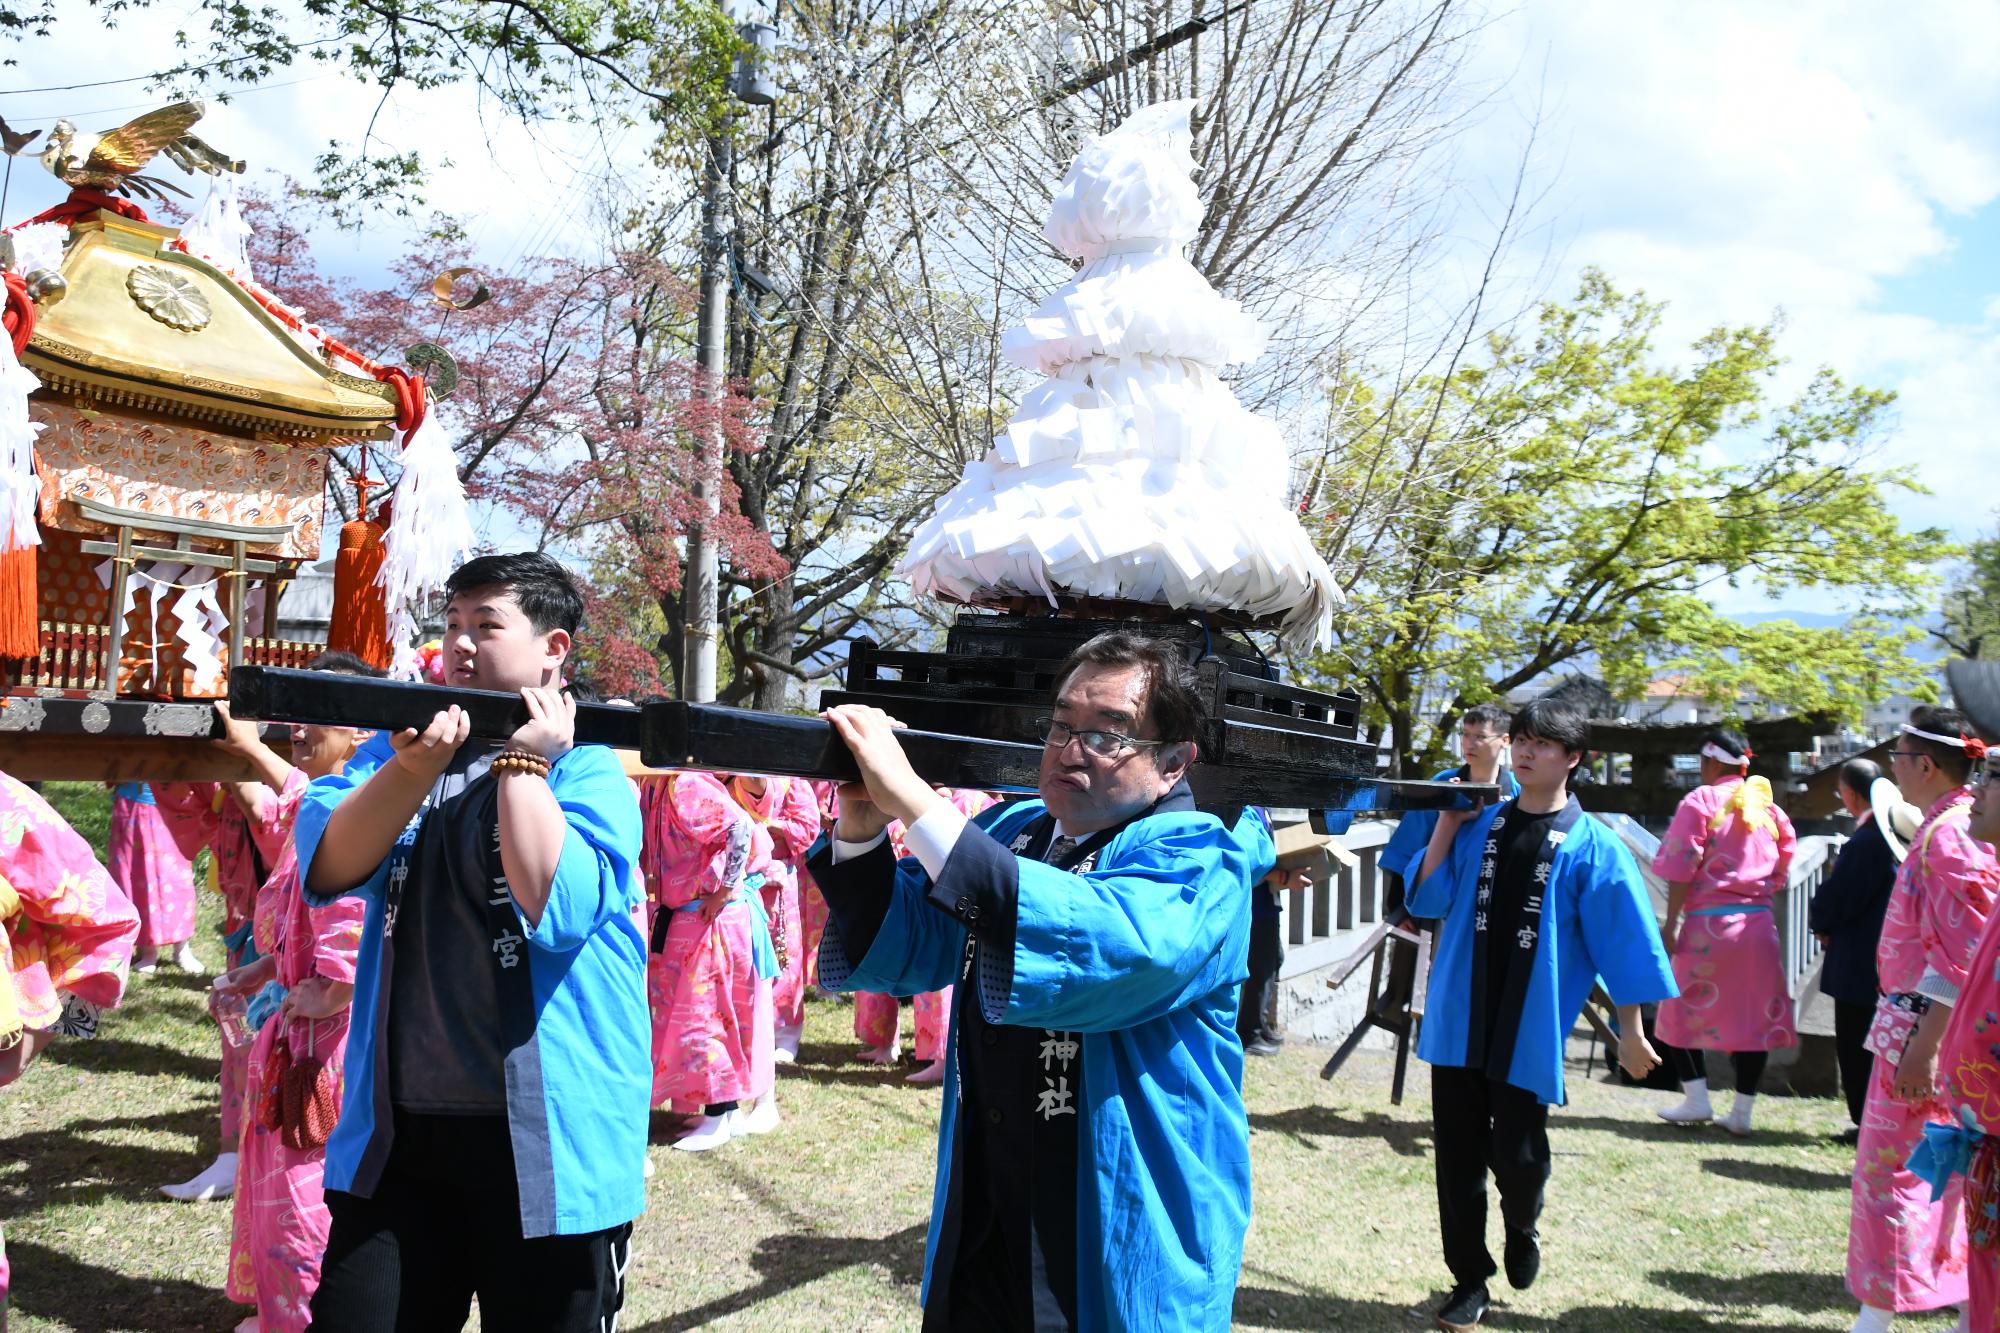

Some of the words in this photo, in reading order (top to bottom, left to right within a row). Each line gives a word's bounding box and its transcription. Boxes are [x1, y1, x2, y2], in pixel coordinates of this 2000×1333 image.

[1516, 829, 1568, 950] 甲斐三宮
[1035, 1029, 1080, 1122] 神社
